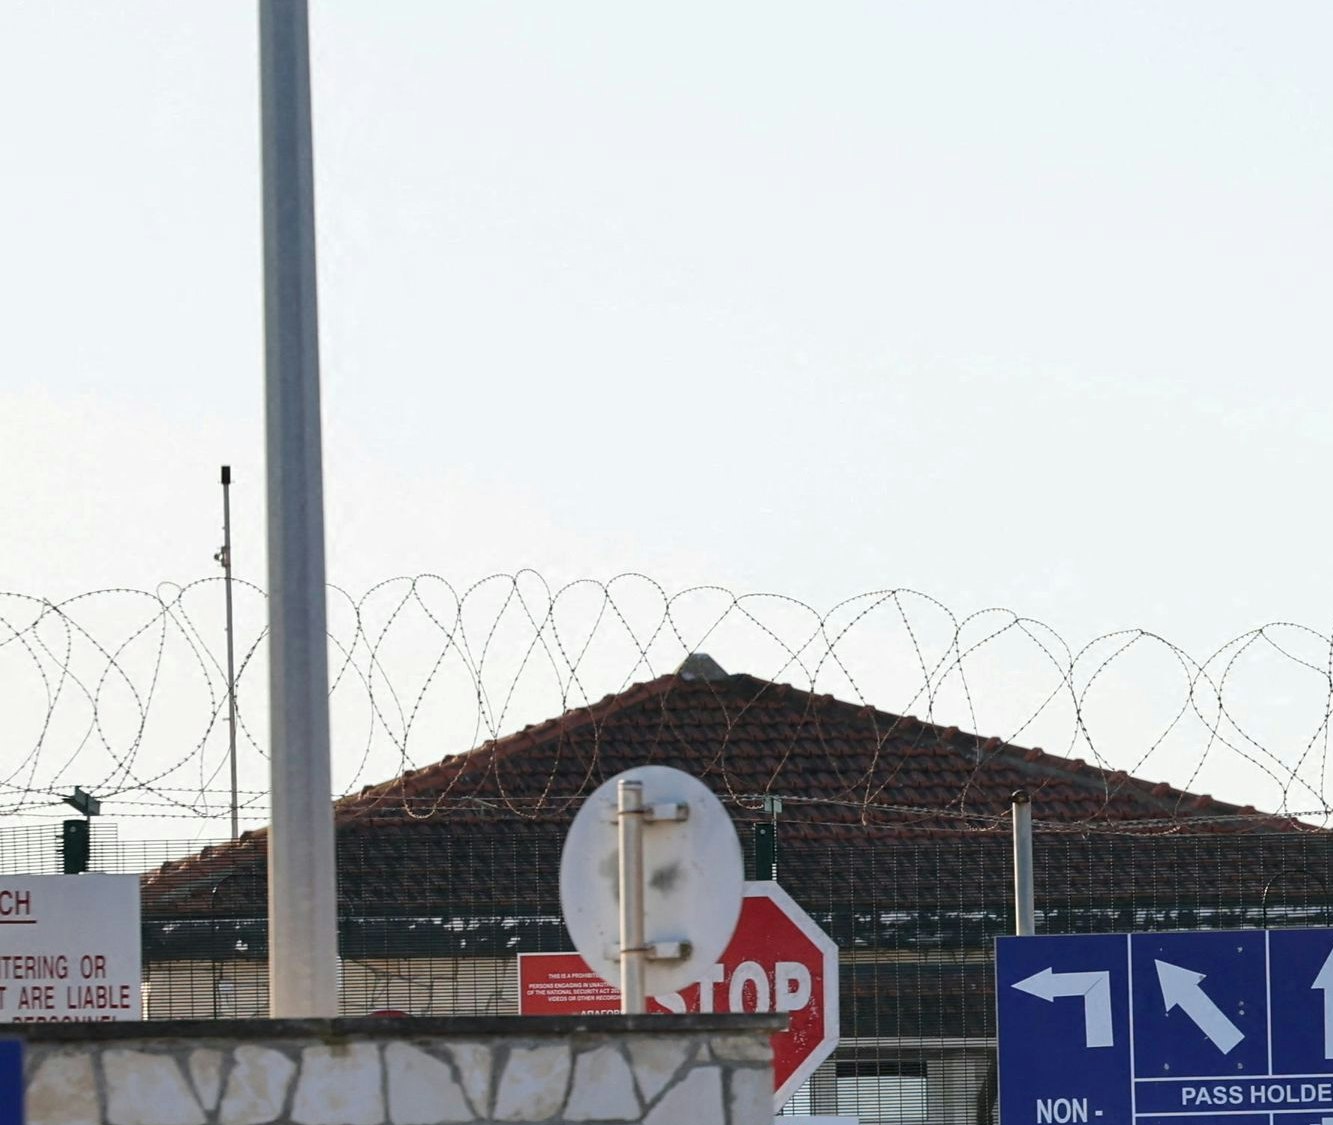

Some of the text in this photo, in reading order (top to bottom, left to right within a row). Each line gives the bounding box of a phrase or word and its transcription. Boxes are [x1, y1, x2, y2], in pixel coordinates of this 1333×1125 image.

[81, 955, 106, 979] OR
[18, 986, 55, 1009] ARE
[67, 985, 130, 1009] LIABLE
[1181, 1086, 1243, 1105] PASS
[1037, 1098, 1088, 1124] NON
